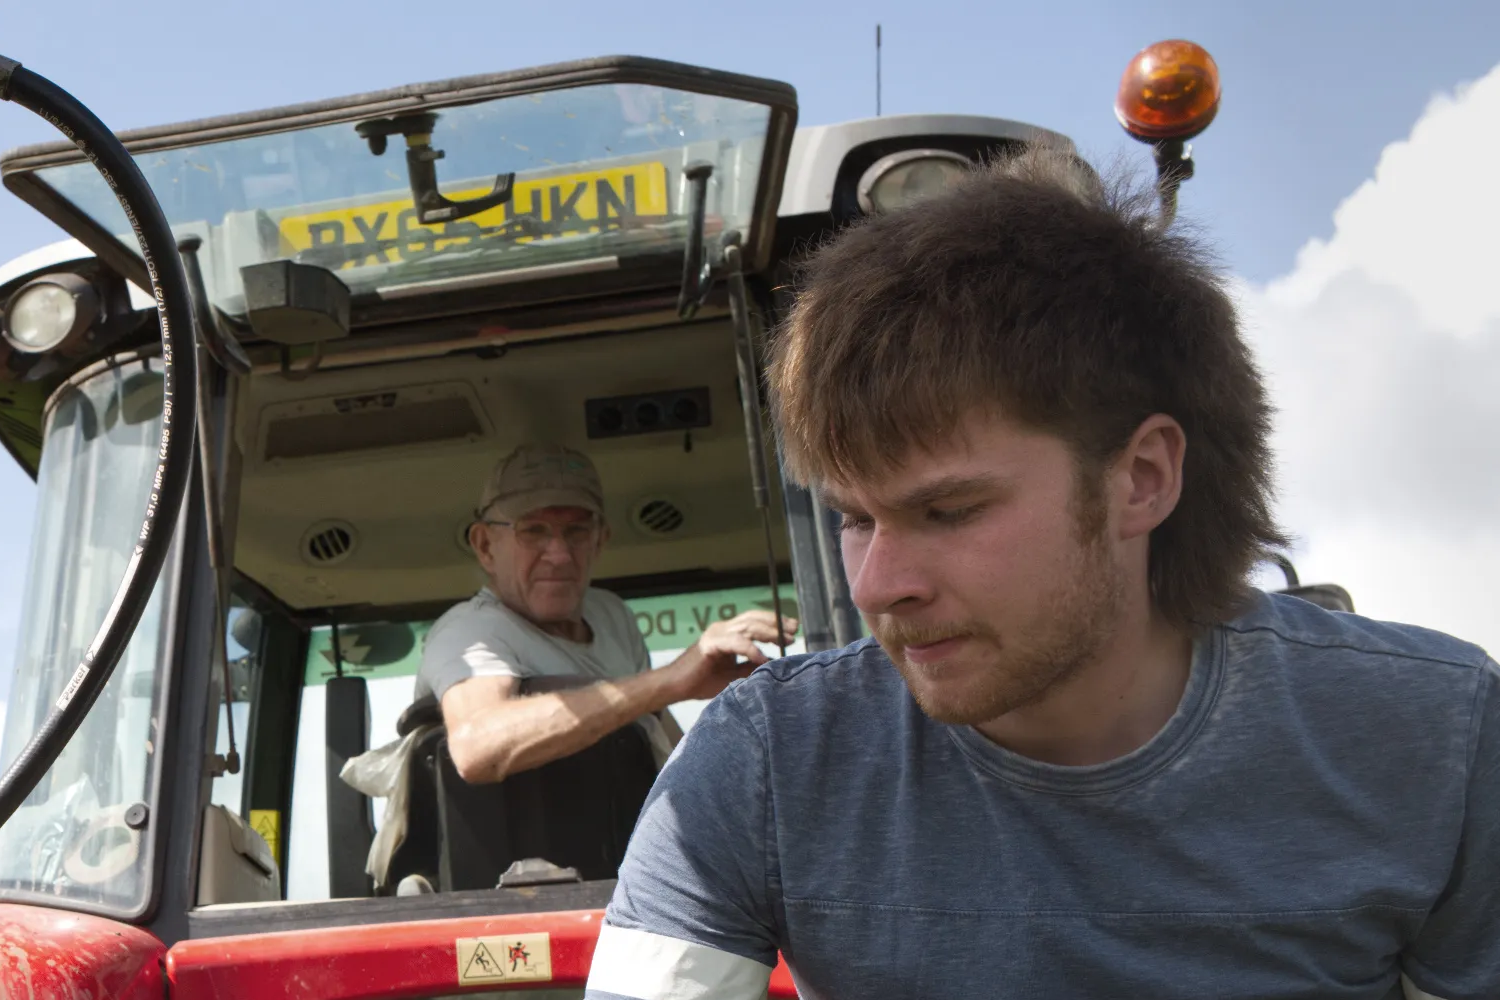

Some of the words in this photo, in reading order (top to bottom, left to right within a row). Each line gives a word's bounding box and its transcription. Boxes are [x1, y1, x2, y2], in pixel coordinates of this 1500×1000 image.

[39, 107, 75, 138] 0575/11
[100, 167, 118, 189] 2SC
[154, 286, 166, 312] (1/2)
[161, 316, 170, 338] mm
[163, 344, 173, 367] 12,5
[163, 400, 173, 424] PSI)
[159, 429, 170, 460] (4495
[153, 464, 165, 490] MPa
[147, 493, 159, 517] 31,0
[140, 520, 149, 540] WP
[63, 667, 87, 701] Parker
